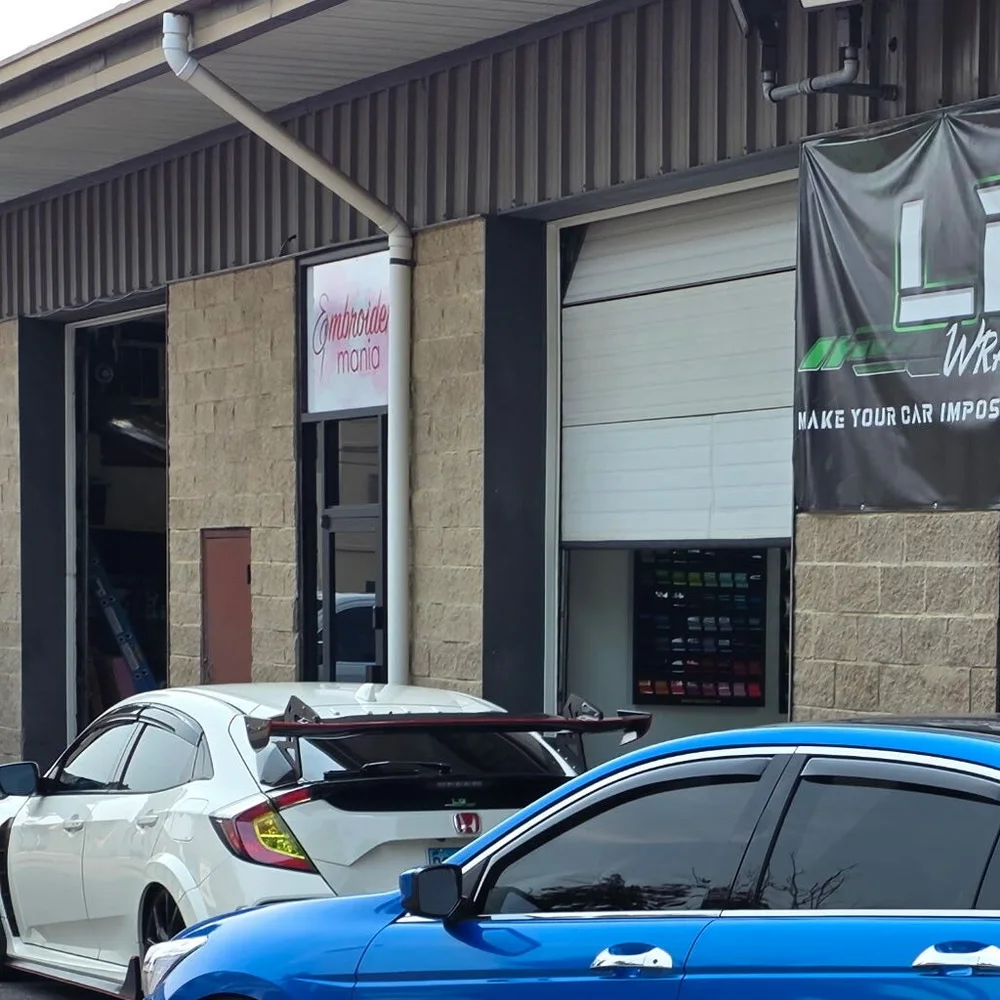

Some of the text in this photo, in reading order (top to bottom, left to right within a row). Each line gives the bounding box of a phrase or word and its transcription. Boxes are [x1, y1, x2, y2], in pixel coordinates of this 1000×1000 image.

[336, 339, 380, 374] mania
[798, 407, 845, 431] MAKE
[851, 405, 897, 428] YOUR
[901, 403, 933, 425] CAR
